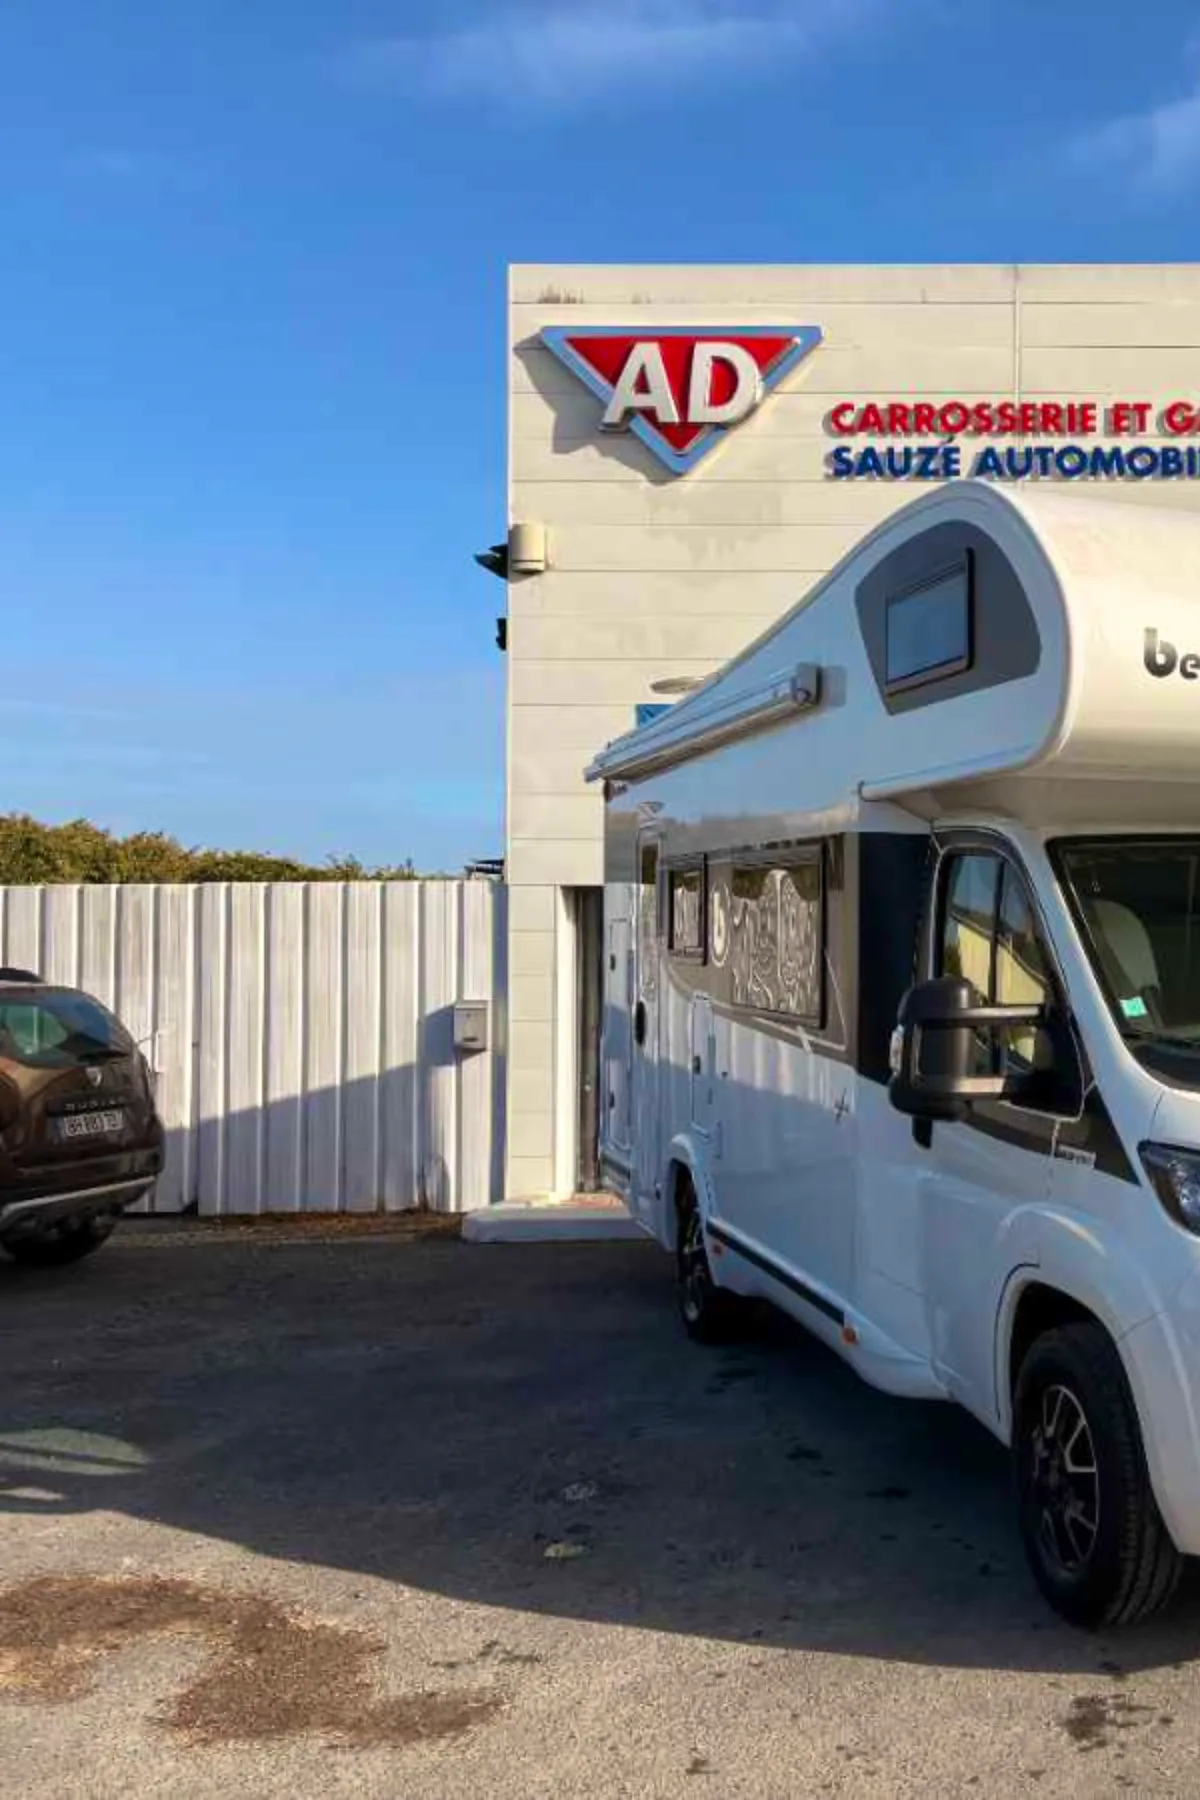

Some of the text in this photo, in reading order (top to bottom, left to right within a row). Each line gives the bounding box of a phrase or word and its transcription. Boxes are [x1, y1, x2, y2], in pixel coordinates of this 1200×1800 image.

[601, 341, 765, 427] AD
[829, 402, 1097, 435] CARROSSERIE
[1112, 403, 1151, 433] ET
